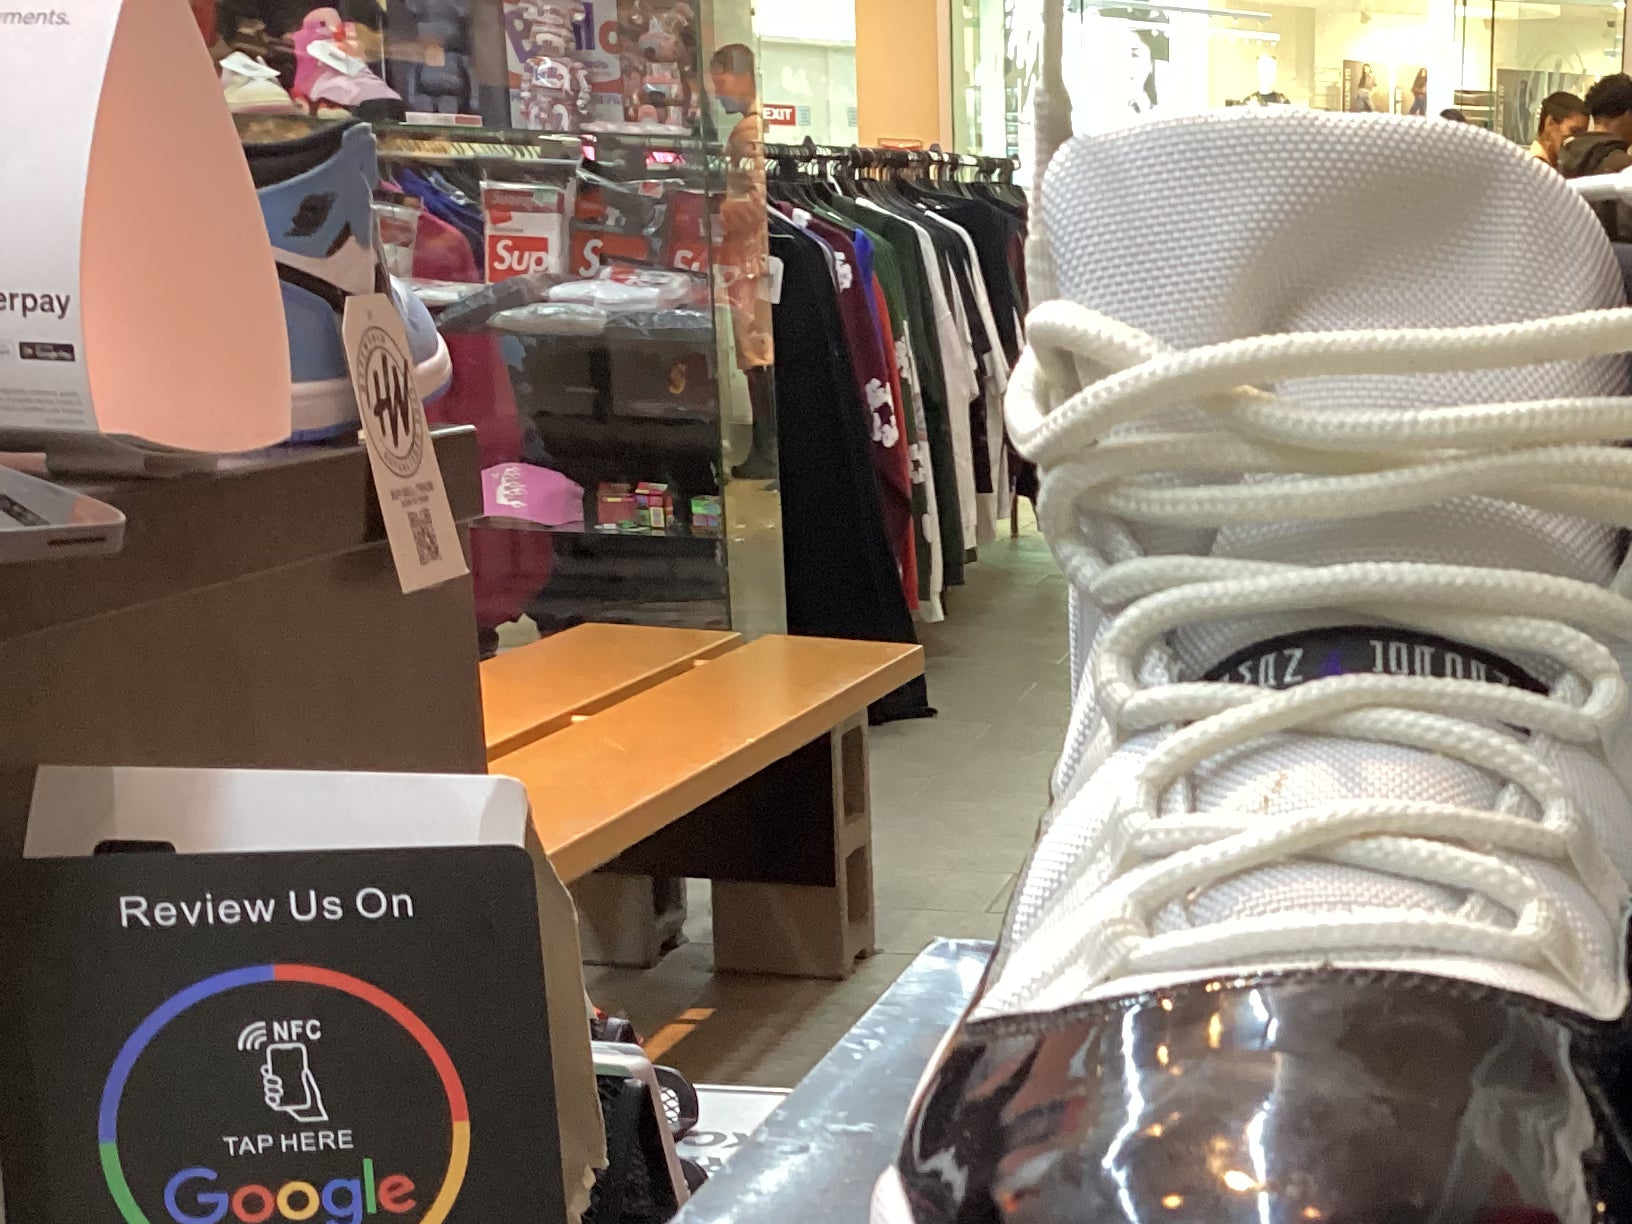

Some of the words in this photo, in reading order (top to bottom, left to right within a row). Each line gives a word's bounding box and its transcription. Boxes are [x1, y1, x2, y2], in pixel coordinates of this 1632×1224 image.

[0, 10, 70, 25] ments.
[763, 108, 792, 120] EXIT
[119, 893, 275, 927] Review
[288, 890, 343, 921] Us
[356, 888, 414, 918] On
[272, 1020, 322, 1041] NFC
[223, 1136, 273, 1157] TAP
[280, 1130, 353, 1153] HERE
